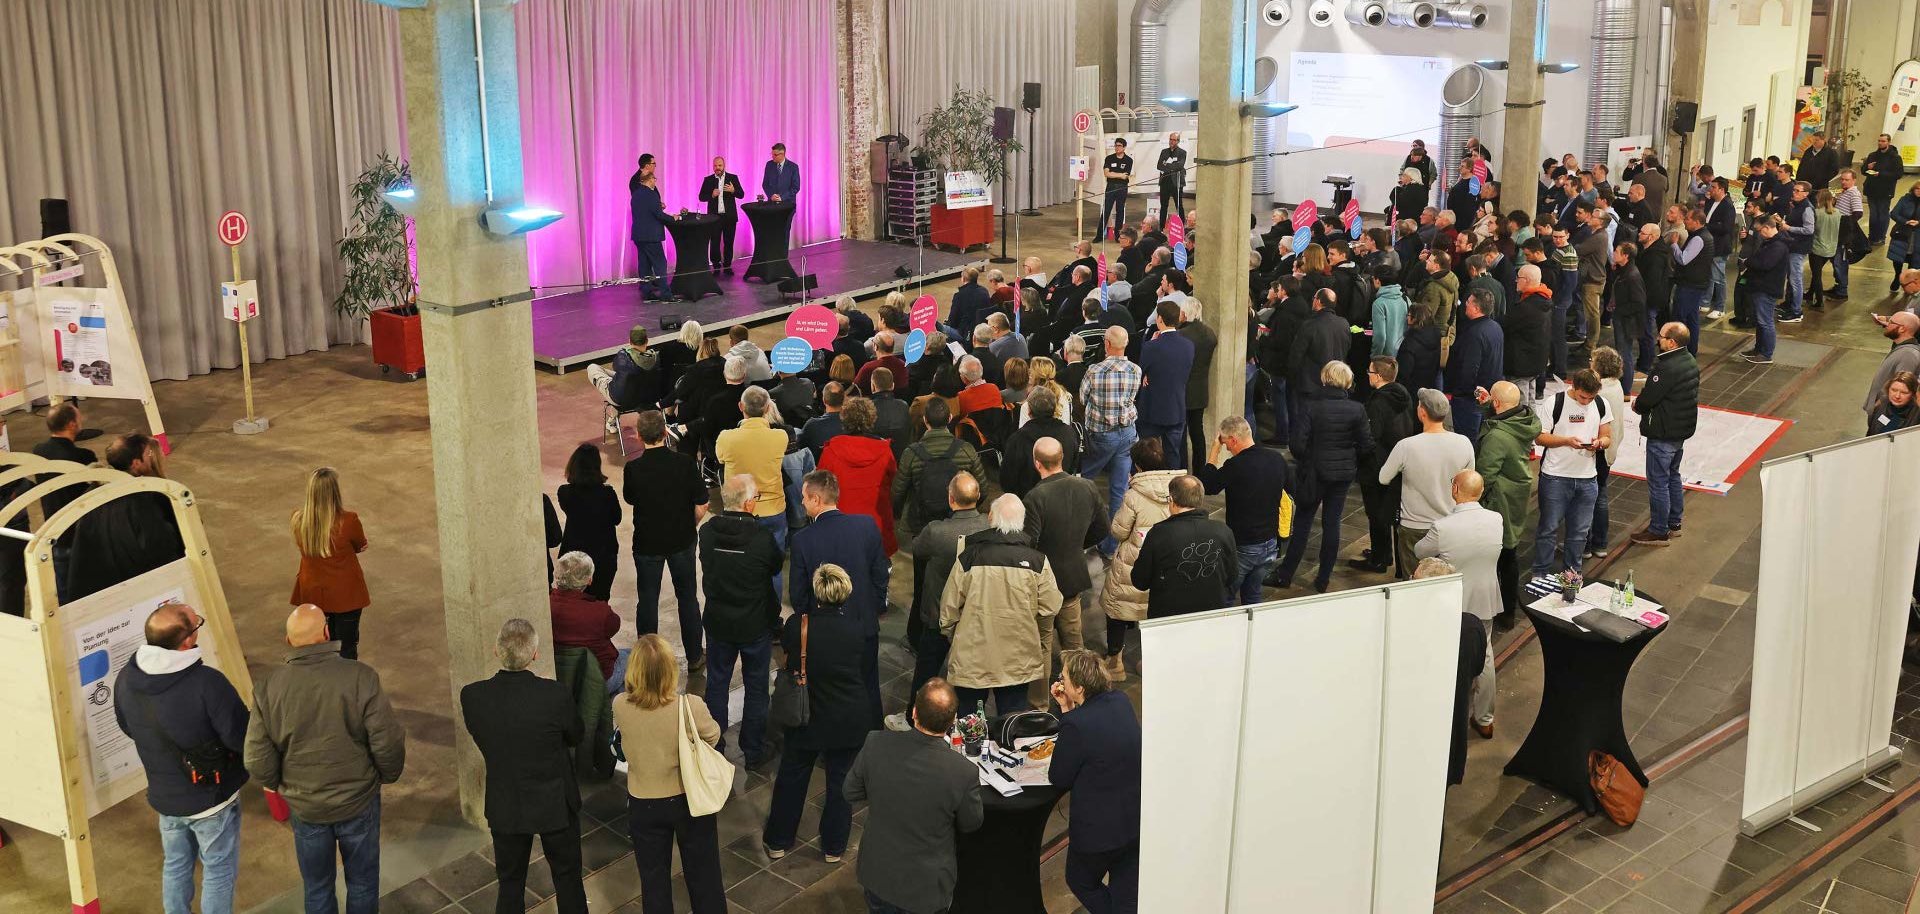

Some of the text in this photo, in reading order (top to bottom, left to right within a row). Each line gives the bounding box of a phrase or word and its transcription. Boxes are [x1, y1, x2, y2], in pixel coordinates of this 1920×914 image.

[1078, 116, 1087, 129] H
[228, 219, 240, 238] H
[82, 620, 131, 644] Von der Idee zur
[83, 638, 109, 651] Planung
